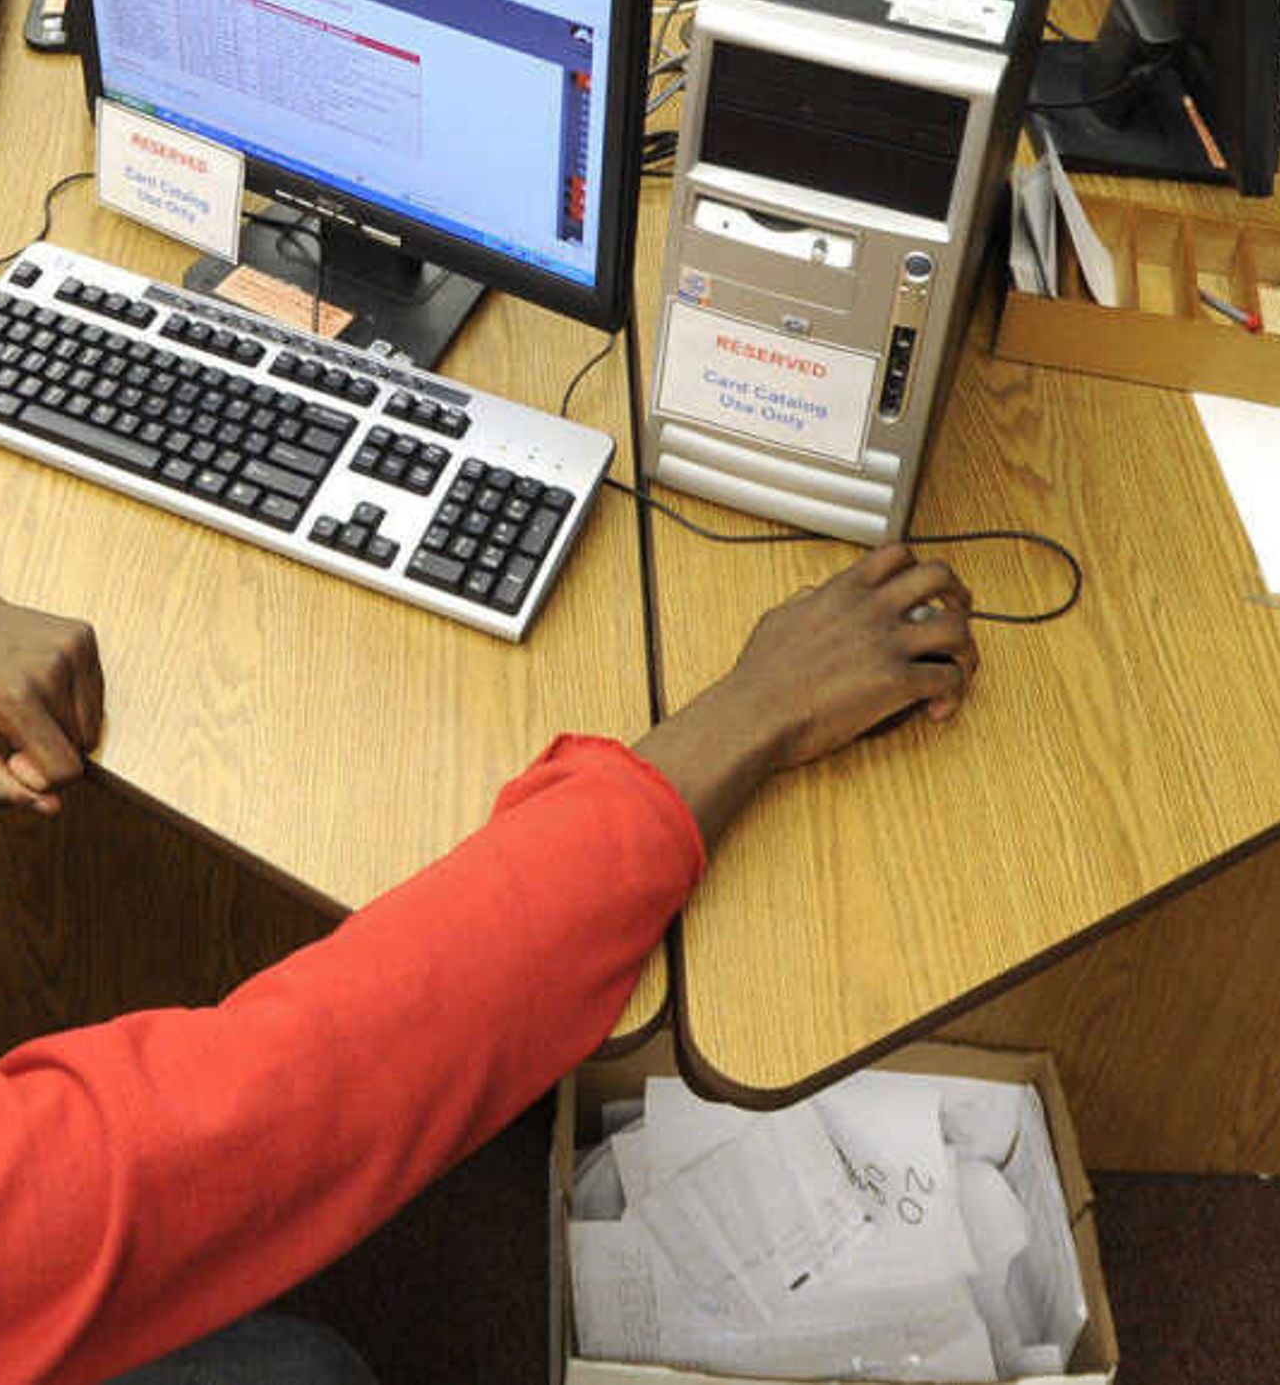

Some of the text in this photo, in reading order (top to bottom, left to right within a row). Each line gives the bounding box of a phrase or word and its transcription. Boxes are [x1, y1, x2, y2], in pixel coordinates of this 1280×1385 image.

[130, 132, 208, 174] RESERVED
[124, 165, 210, 215] Card Catalog
[717, 334, 827, 378] RESERVED
[703, 368, 829, 420] Card Catalog
[719, 393, 804, 432] Use Only
